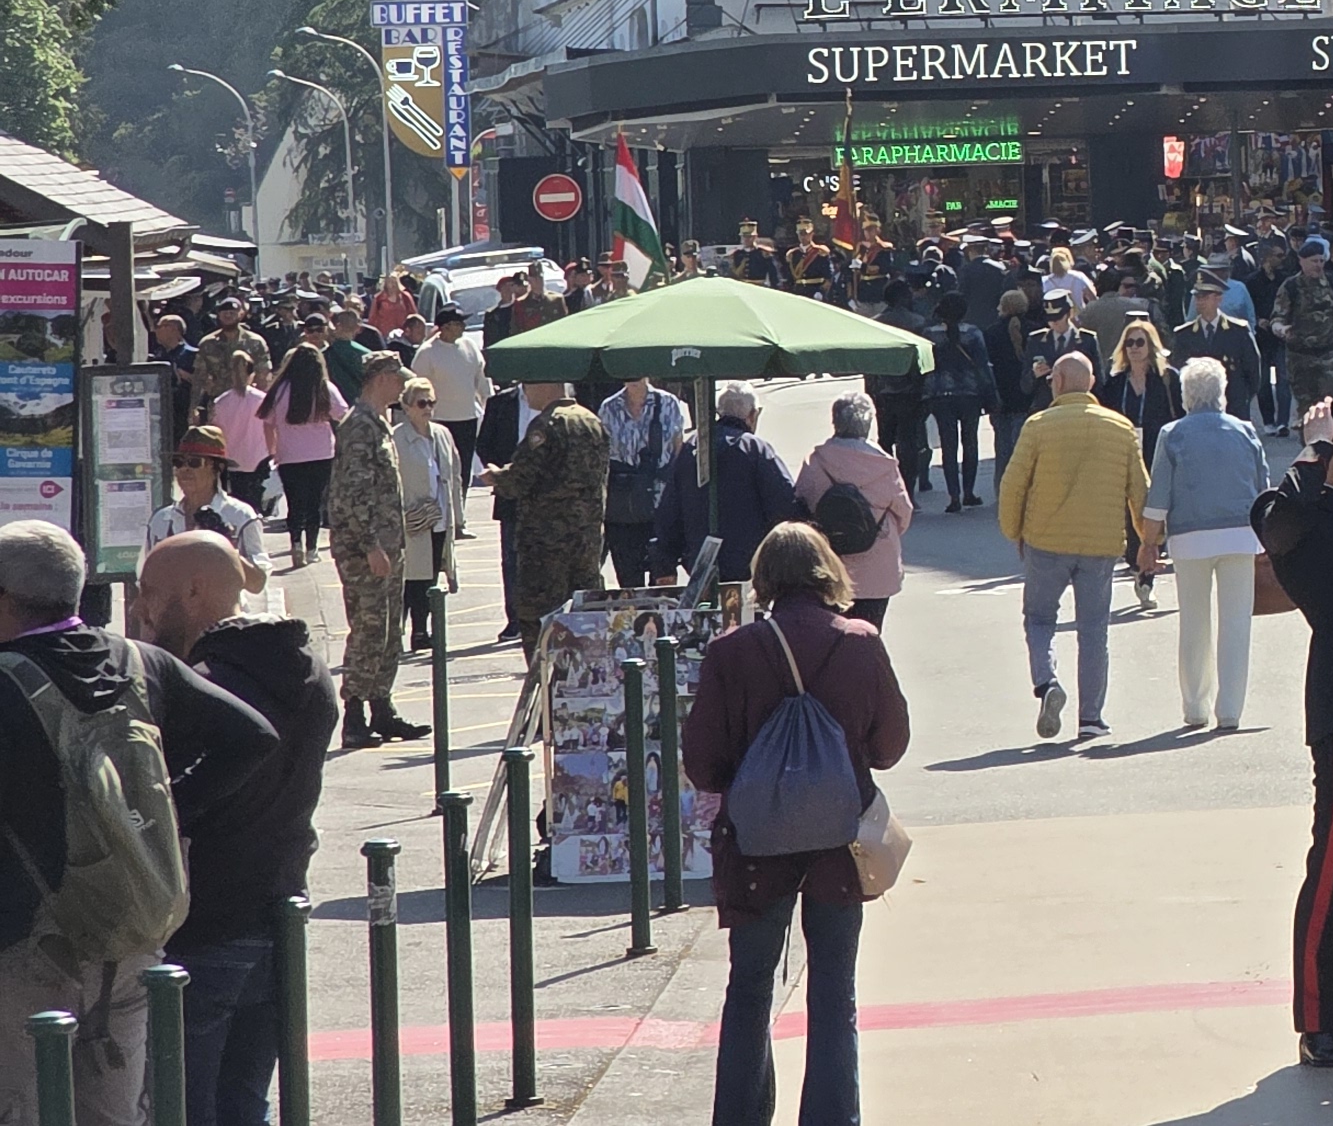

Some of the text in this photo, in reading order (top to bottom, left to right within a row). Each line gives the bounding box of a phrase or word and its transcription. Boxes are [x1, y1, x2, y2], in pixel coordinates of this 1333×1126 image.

[373, 2, 464, 25] BUFFET
[385, 27, 438, 45] BAR
[807, 39, 1137, 84] SUPERMARKET
[446, 27, 466, 165] RESTAURANT
[834, 141, 1022, 167] PARAPHARMACIE
[8, 269, 70, 282] AUTOCAR
[1, 293, 68, 305] excursions
[6, 448, 53, 459] Cirque de
[8, 459, 52, 469] Gavarnie
